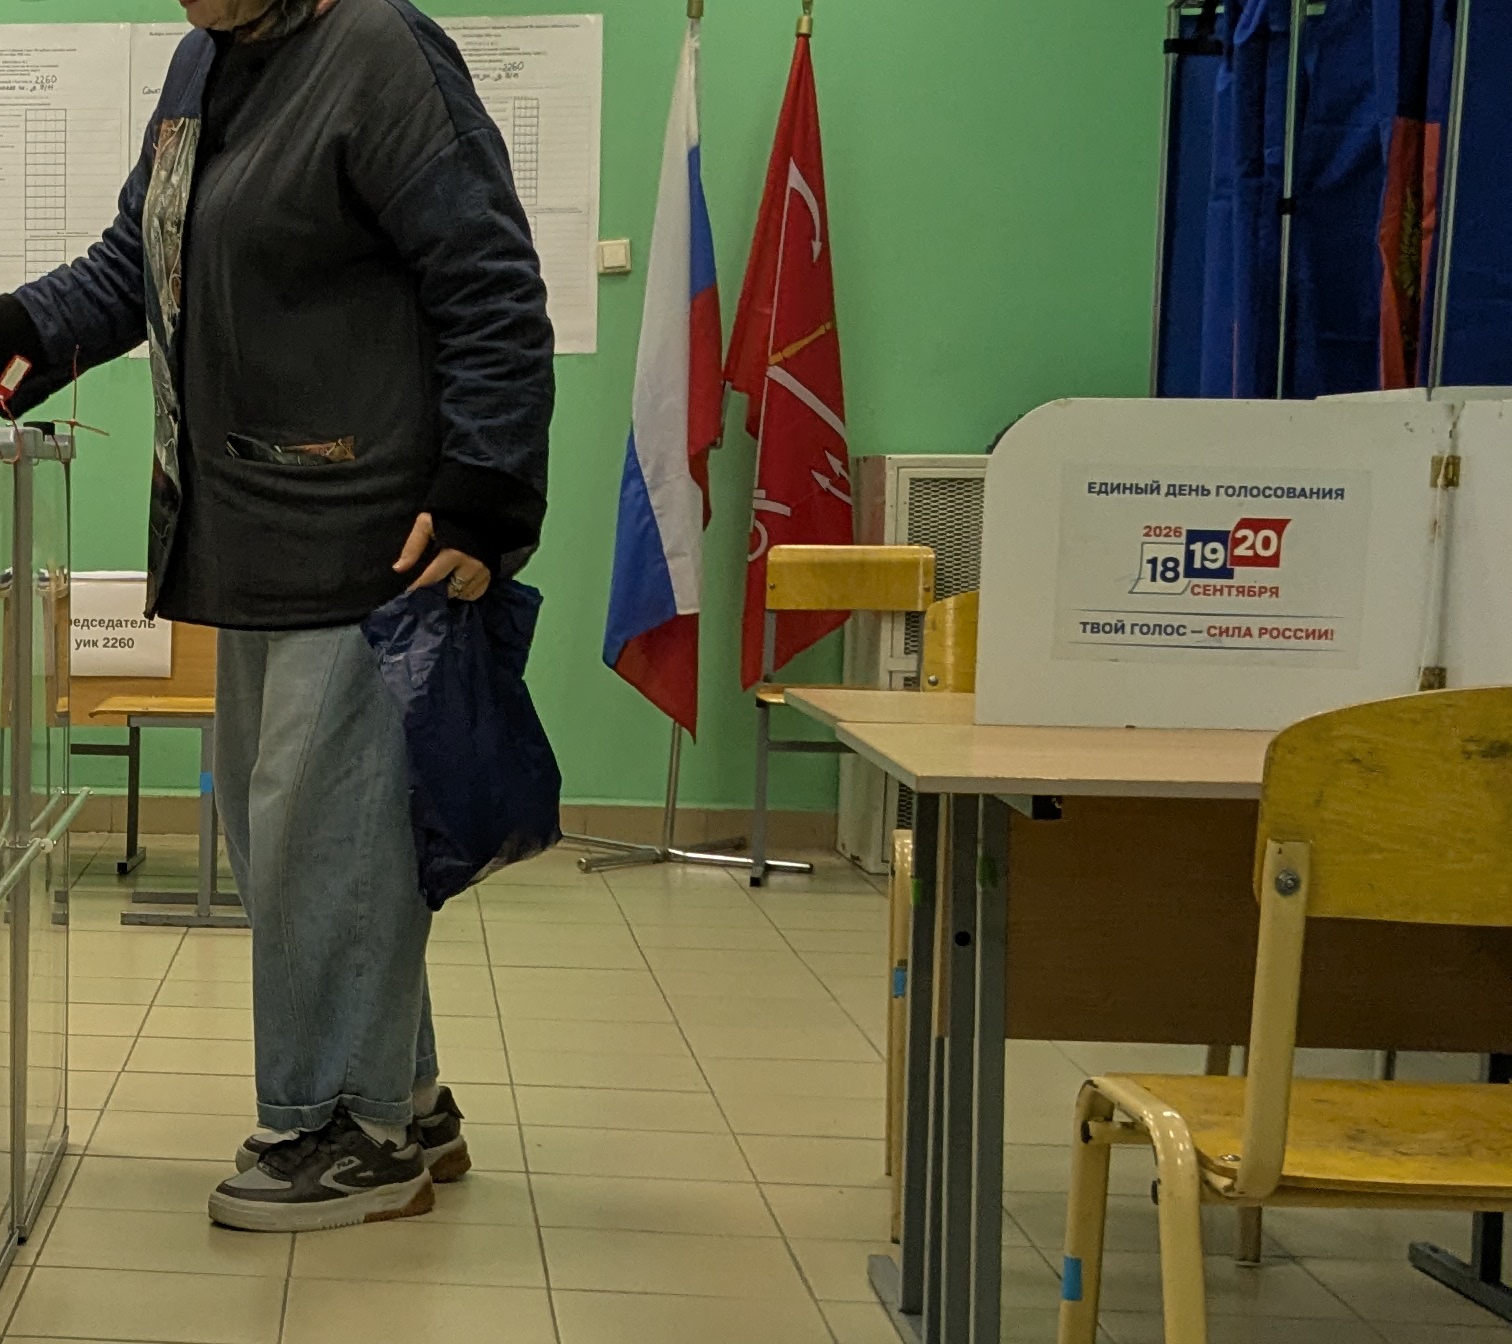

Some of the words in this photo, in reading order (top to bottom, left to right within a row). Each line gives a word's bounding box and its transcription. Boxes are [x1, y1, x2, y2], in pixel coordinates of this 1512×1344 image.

[35, 74, 57, 84] 2260
[1087, 480, 1161, 496] ЕДИНЫЙ
[1164, 483, 1211, 498] ДЕНЬ
[1216, 485, 1346, 500] ГОЛОСОВАНИЯ
[1142, 525, 1183, 538] 2026
[1146, 556, 1180, 583] 18
[1189, 542, 1226, 569] 19
[1233, 529, 1278, 556] 20
[1190, 583, 1280, 598] СЕНТЯБРЯ
[1079, 620, 1126, 636] ТВОЙ
[1130, 622, 1187, 638] ГОЛОС
[1206, 624, 1253, 640] СИЛА
[1258, 626, 1335, 641] РОССИИ!
[75, 638, 99, 650] уик
[102, 637, 134, 648] 2260
